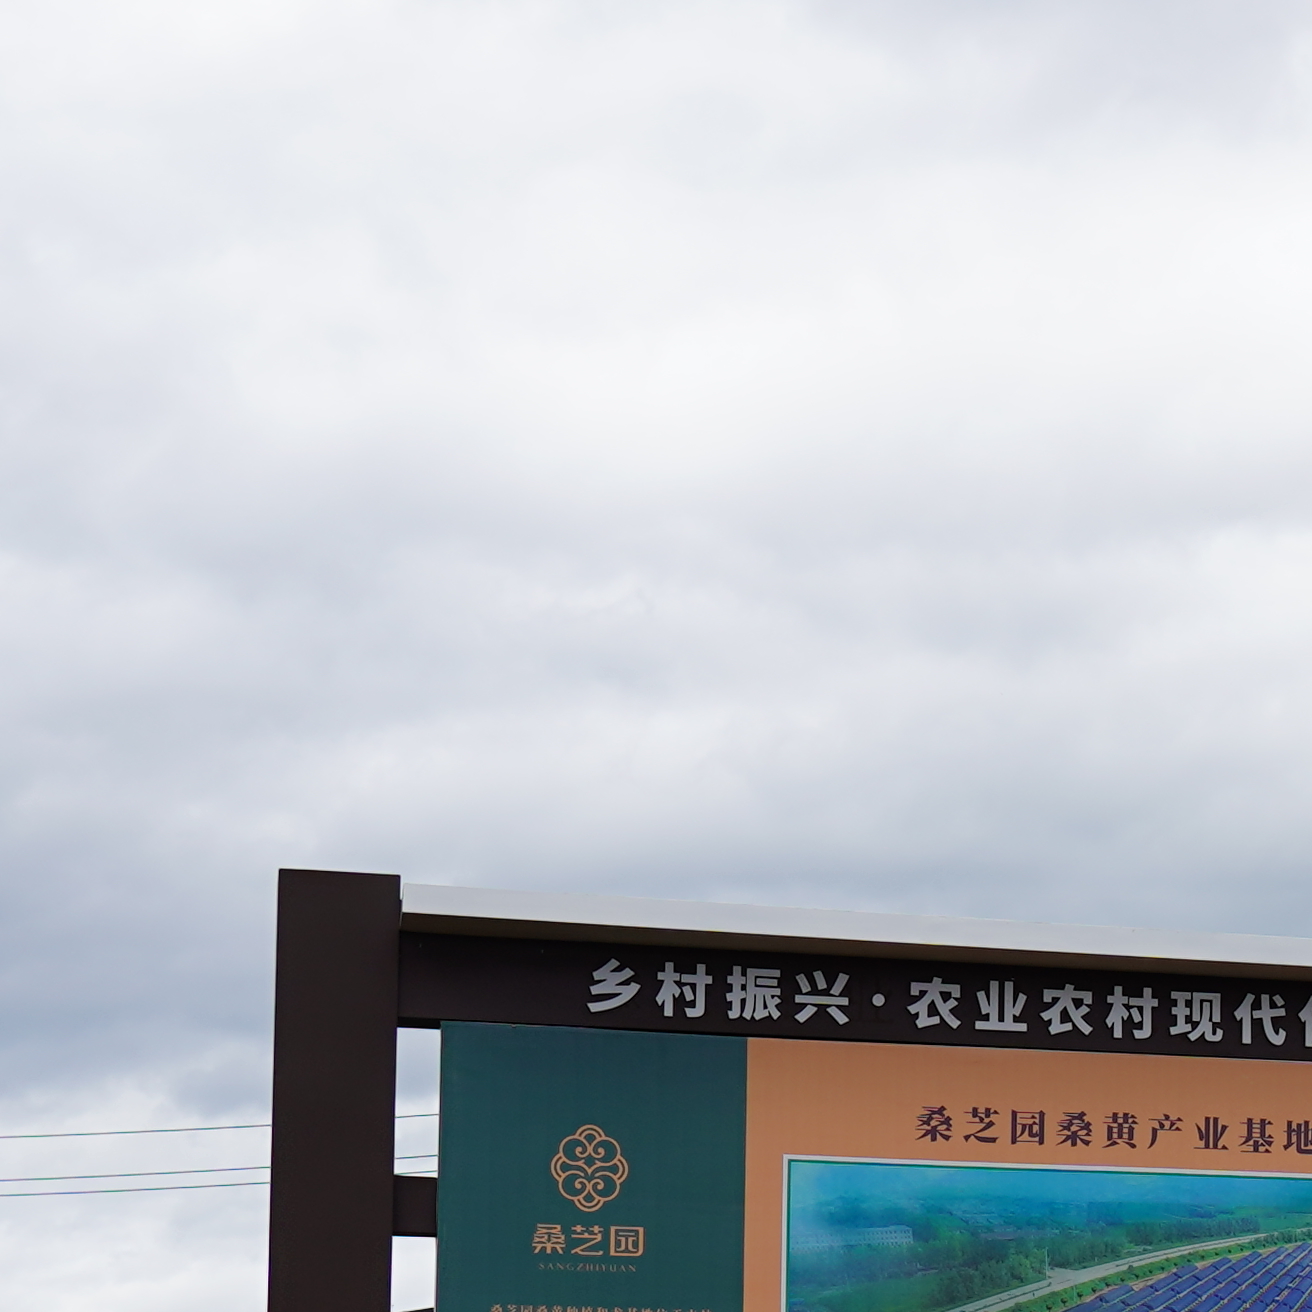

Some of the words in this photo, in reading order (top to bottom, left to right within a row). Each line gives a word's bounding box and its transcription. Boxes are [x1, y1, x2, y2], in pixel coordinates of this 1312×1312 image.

[531, 1223, 645, 1257] 桑芝园
[538, 1262, 637, 1273] SANGZHIYUAN
